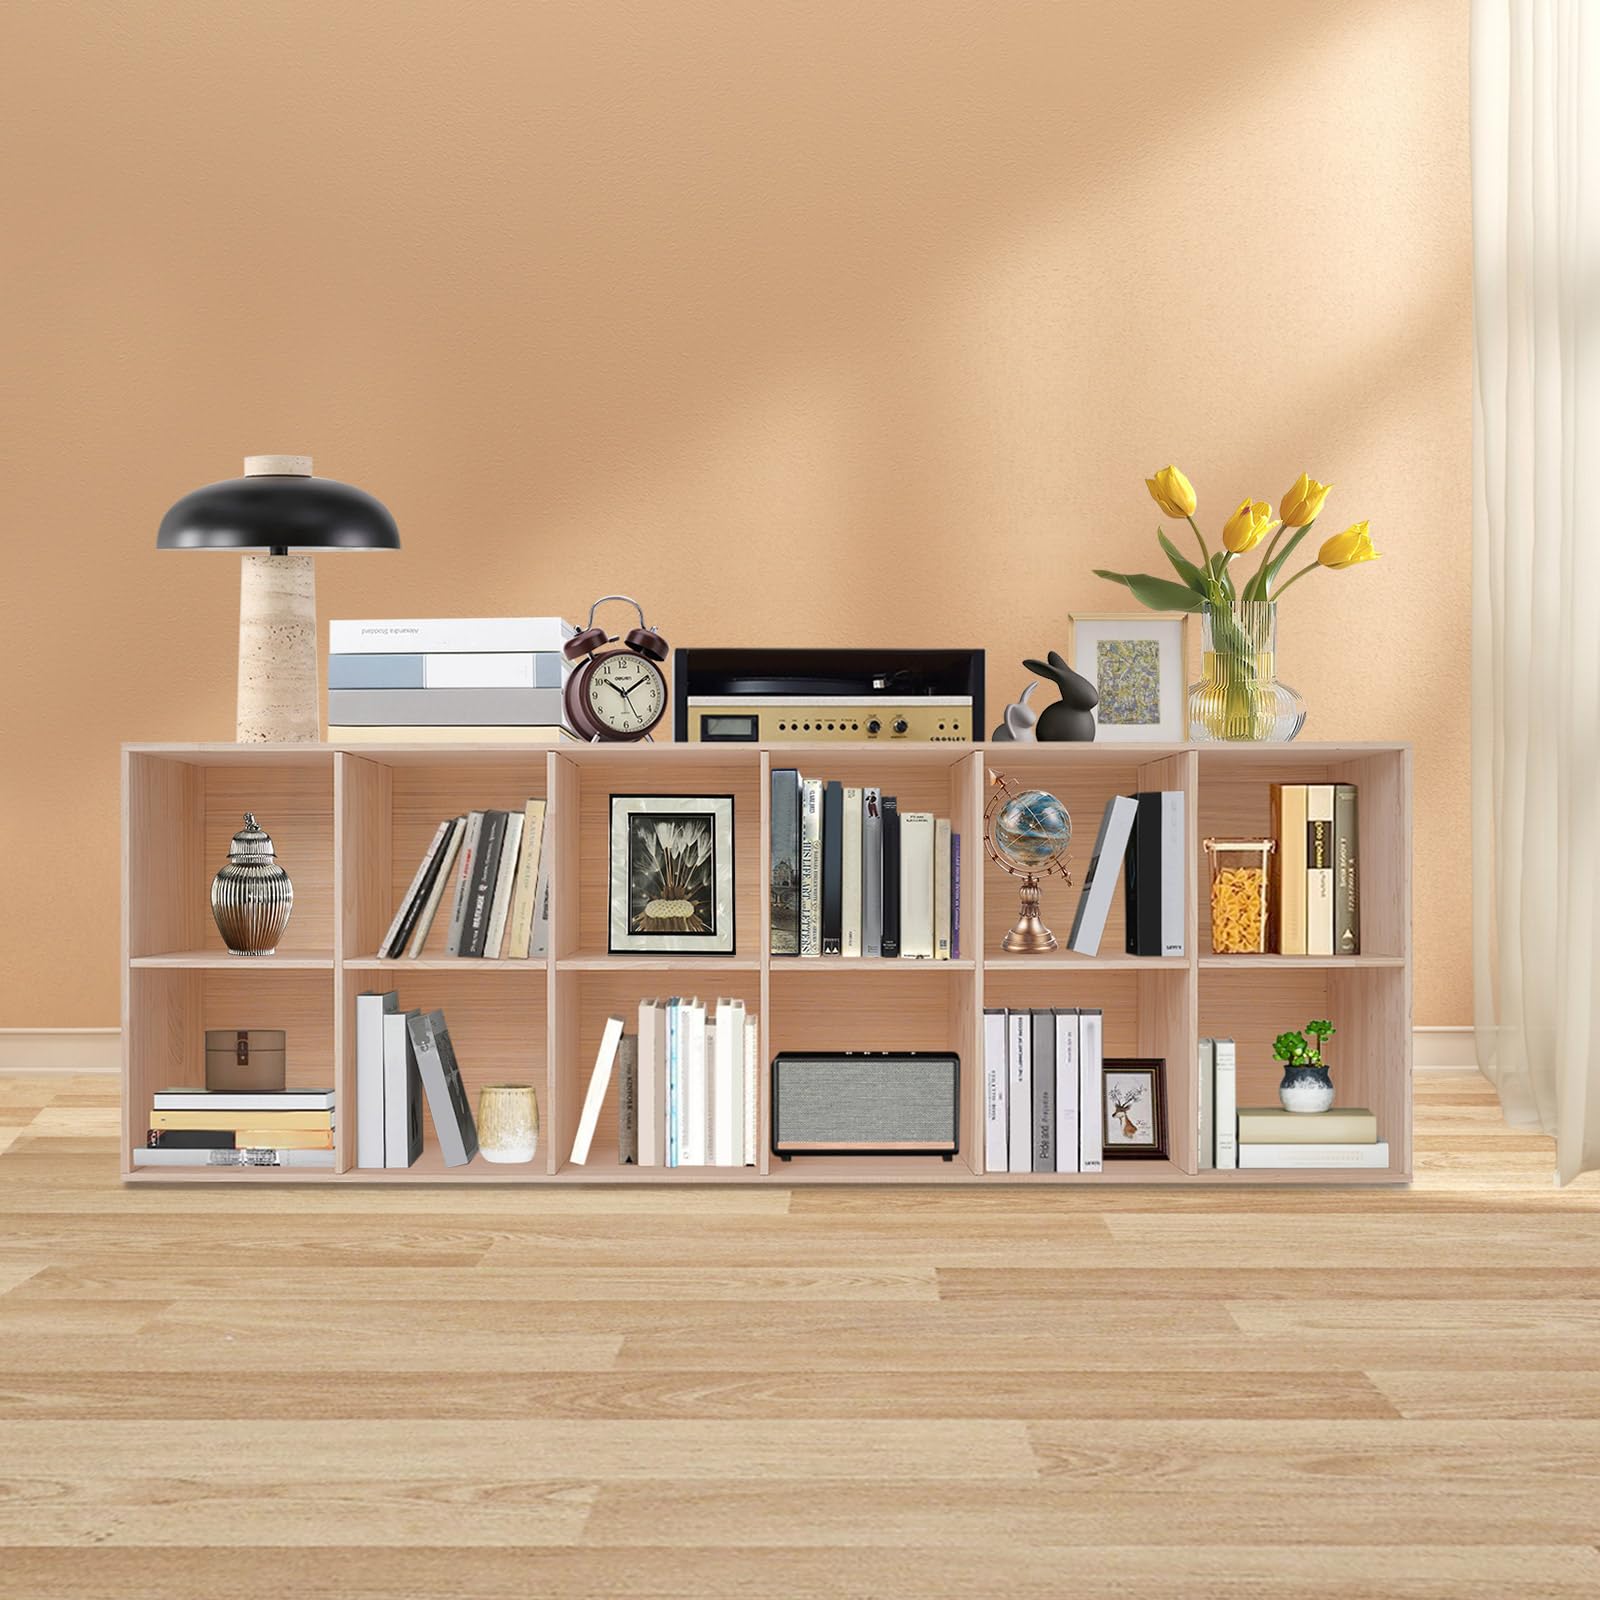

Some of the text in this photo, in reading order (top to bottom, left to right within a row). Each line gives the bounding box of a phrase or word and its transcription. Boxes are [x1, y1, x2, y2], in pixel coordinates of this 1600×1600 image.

[618, 660, 627, 669] 12
[603, 666, 611, 674] 11
[636, 665, 640, 674] 1
[595, 678, 604, 686] 10
[592, 692, 598, 700] 9
[650, 689, 656, 698] 3
[597, 706, 603, 715] 8
[647, 704, 652, 713] 4
[609, 716, 615, 724] 7
[637, 715, 643, 723] 5
[623, 720, 629, 729] 6
[802, 841, 811, 858] HIS
[802, 858, 811, 879] LIFE
[802, 883, 811, 900] ART
[801, 909, 811, 953] LETTERS
[1038, 1125, 1049, 1140] and
[1039, 1140, 1050, 1159] Pride
